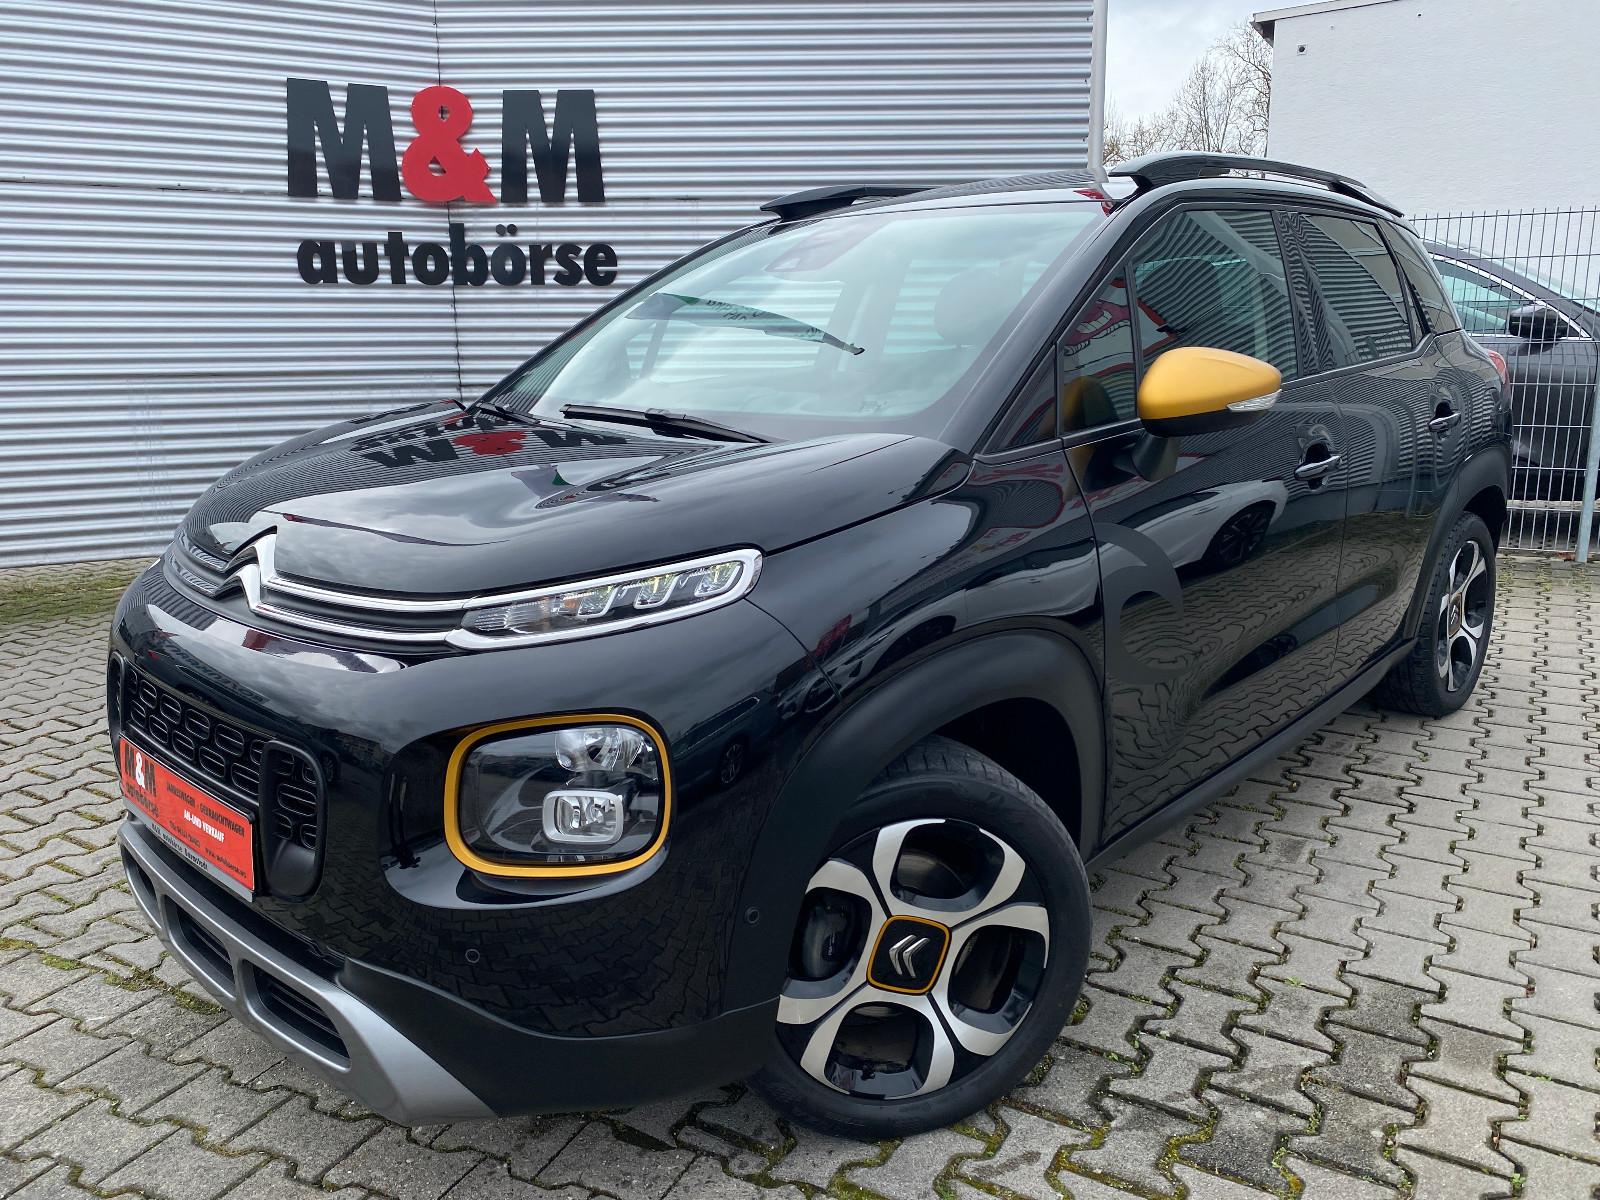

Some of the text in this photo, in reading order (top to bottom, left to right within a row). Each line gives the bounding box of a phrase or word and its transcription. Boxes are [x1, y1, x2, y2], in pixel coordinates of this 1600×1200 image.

[287, 78, 605, 205] M&M
[297, 223, 618, 286] autobörse
[125, 743, 156, 797] M&M
